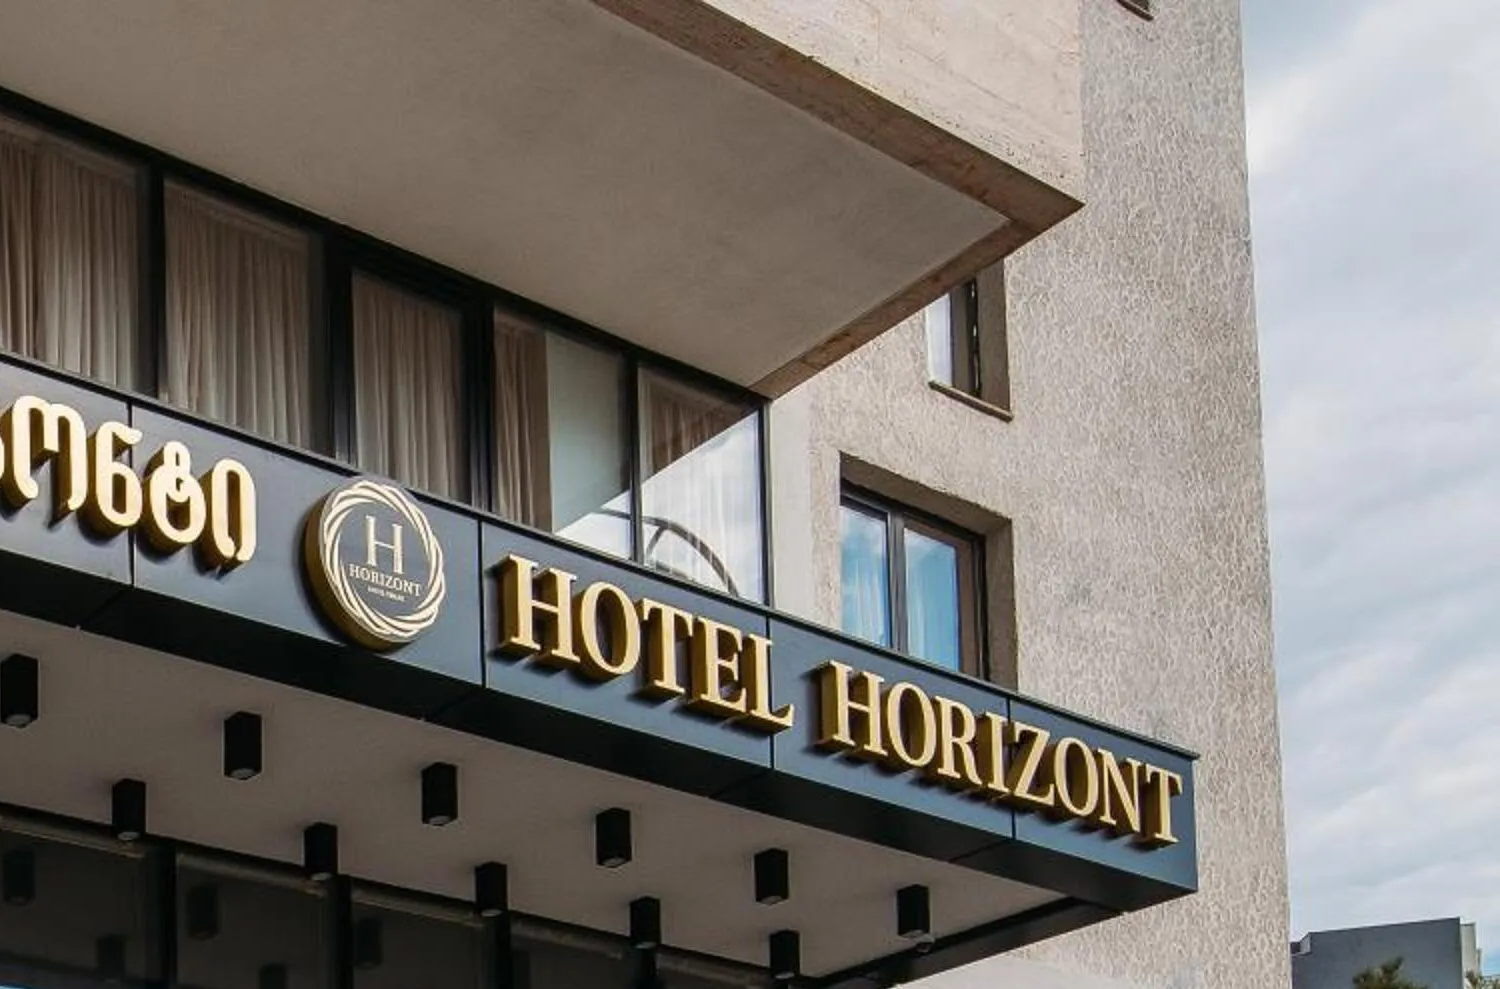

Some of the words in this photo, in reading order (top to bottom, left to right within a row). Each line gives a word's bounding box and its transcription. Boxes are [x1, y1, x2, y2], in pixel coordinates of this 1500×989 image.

[365, 514, 404, 575] H
[349, 563, 421, 597] HORIZONT
[500, 554, 795, 733] HOTEL
[819, 659, 1184, 847] HORIZONT
